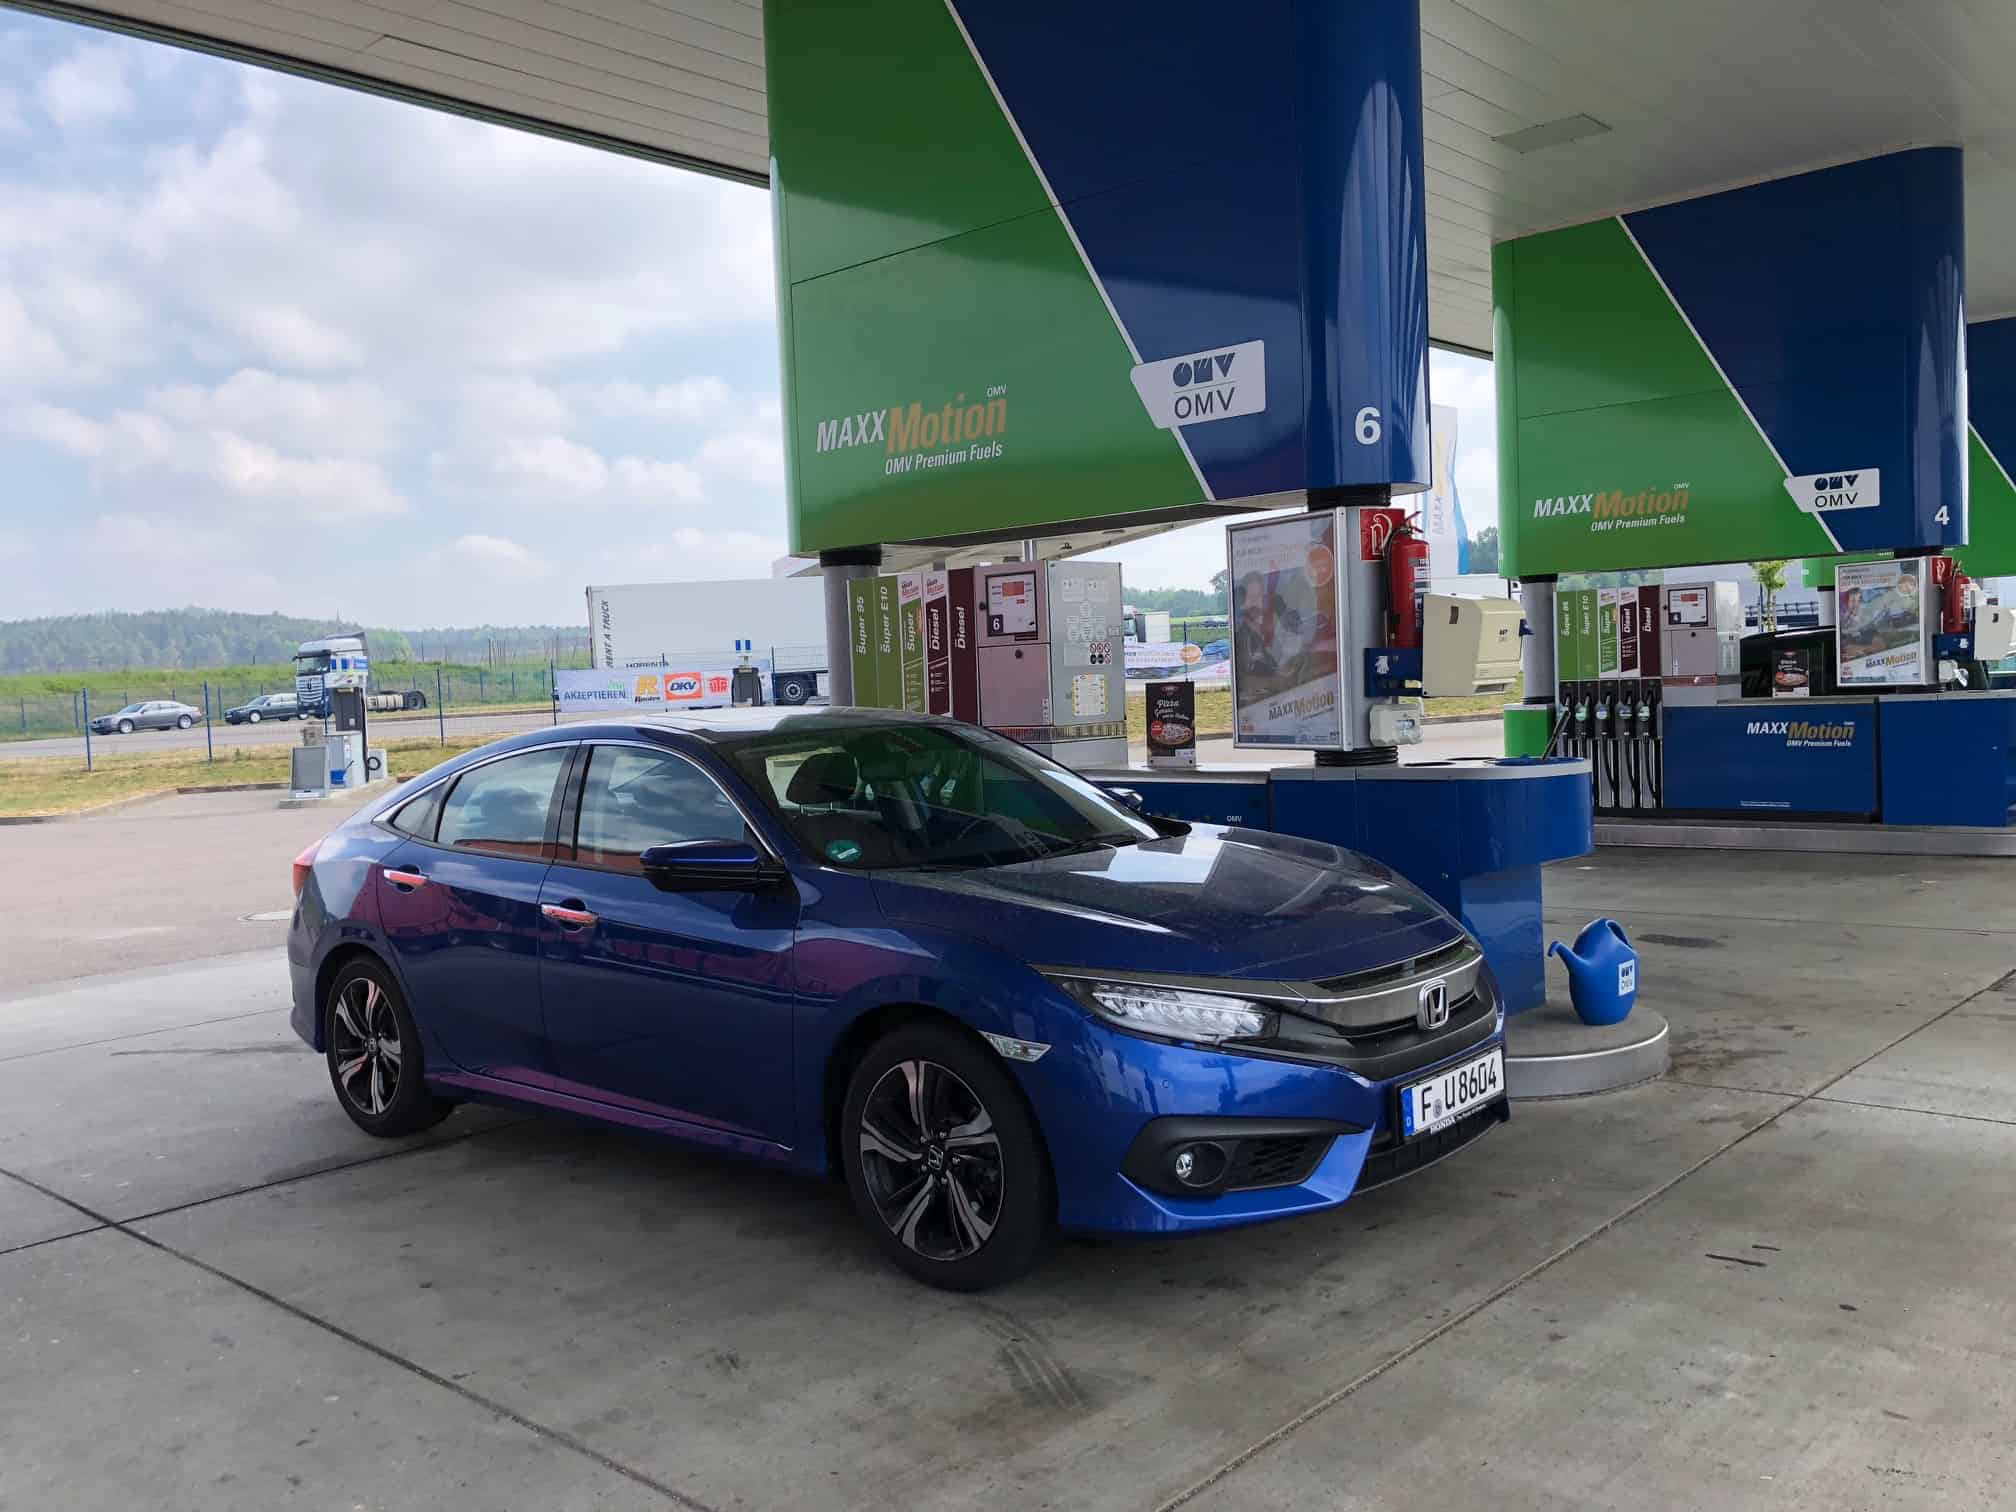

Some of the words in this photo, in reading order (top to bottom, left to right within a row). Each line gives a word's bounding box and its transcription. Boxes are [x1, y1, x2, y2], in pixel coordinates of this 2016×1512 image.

[987, 384, 1007, 397] OMV
[1174, 387, 1235, 419] OMV
[1355, 406, 1381, 445] 6
[885, 456, 913, 475] OMV
[915, 449, 967, 471] Premium
[970, 441, 1003, 461] Fuels
[1814, 492, 1858, 508] OMV
[1591, 520, 1614, 532] OMV
[1616, 517, 1657, 529] Premium
[1659, 513, 1685, 525] Fuels
[1934, 505, 1950, 525] 4
[880, 586, 889, 611] E10
[601, 600, 611, 630] TRUCK
[957, 606, 966, 649] Diesel
[993, 618, 1000, 630] 6
[604, 633, 611, 641] A
[856, 616, 867, 655] Super
[881, 614, 892, 654] Super
[907, 612, 916, 652] Super
[930, 608, 940, 650] Diesel
[564, 690, 626, 701] AKZEPTIEREN
[670, 681, 697, 691] DKV
[1746, 721, 1789, 735] MAXX
[1227, 815, 1242, 823] OMV
[1421, 1086, 1433, 1121] F
